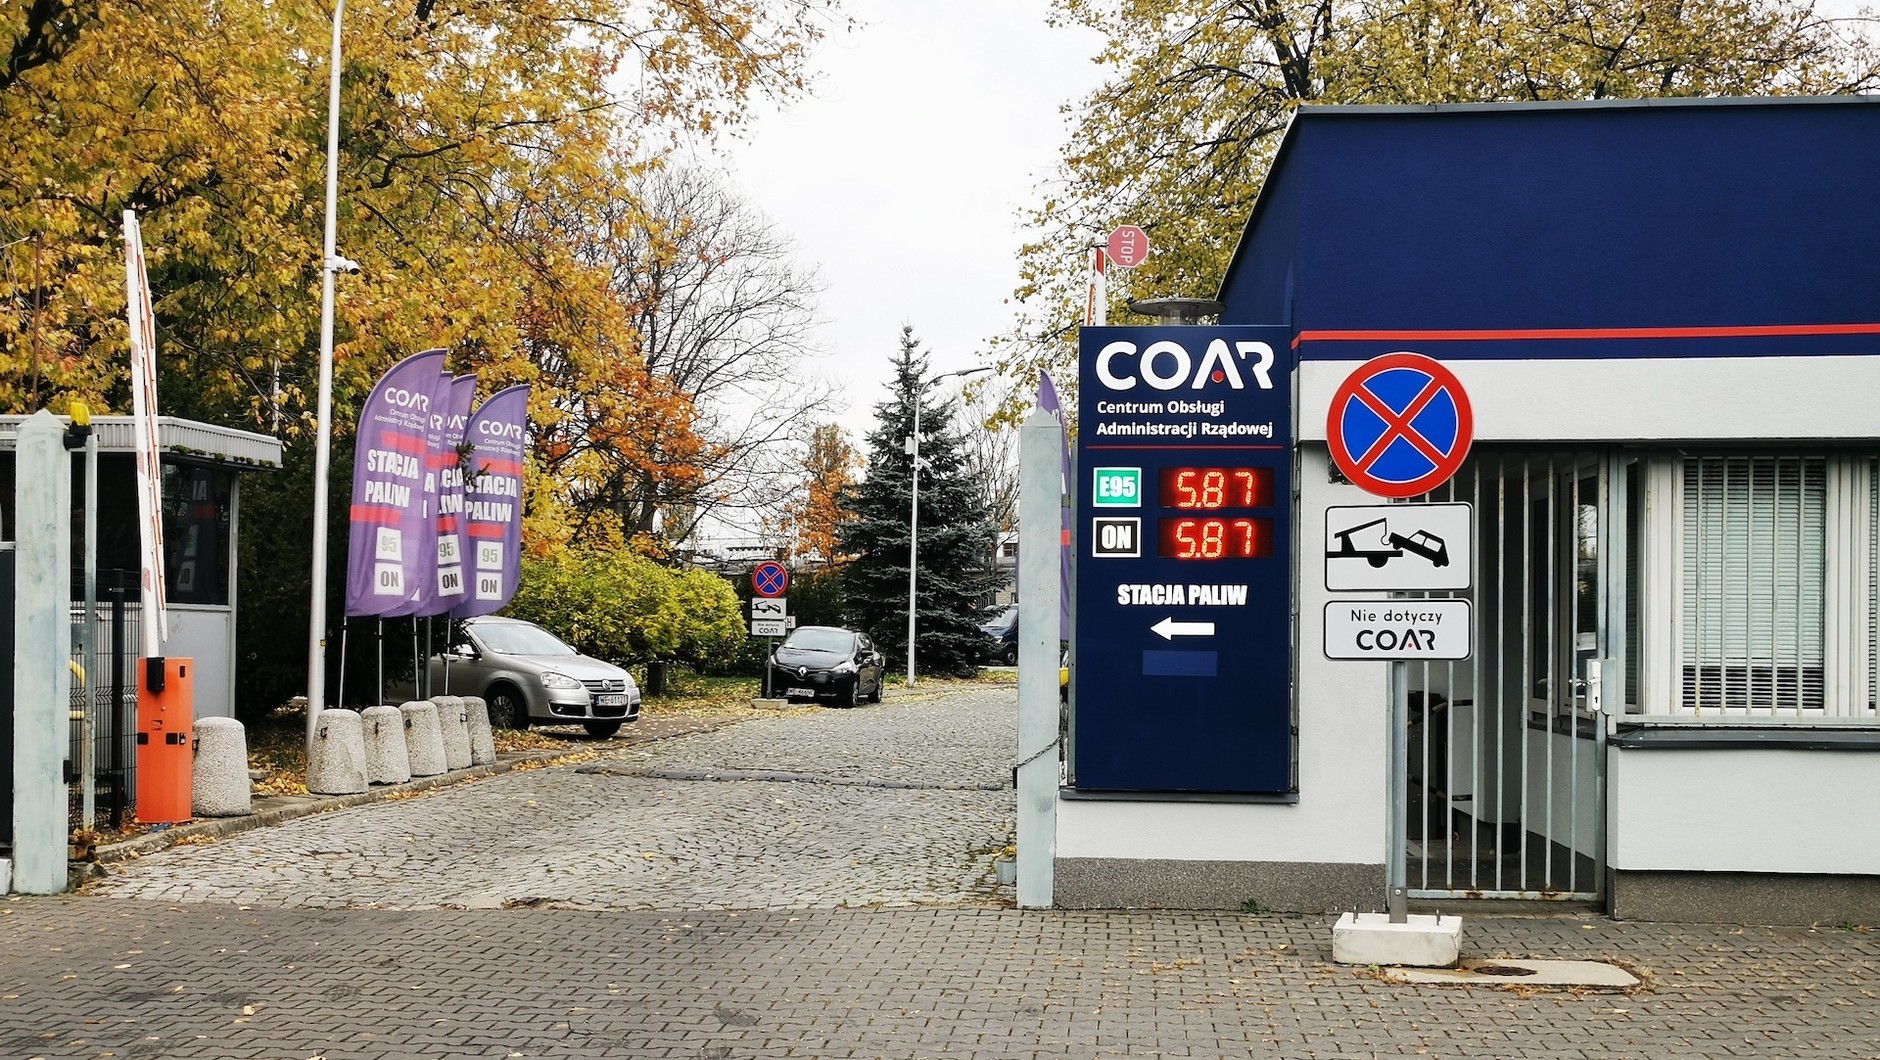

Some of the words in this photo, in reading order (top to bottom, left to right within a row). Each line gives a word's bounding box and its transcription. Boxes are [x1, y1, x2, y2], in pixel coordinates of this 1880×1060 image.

[1120, 230, 1135, 264] STOP
[1096, 338, 1275, 391] COAR
[384, 387, 430, 412] COAR
[1097, 400, 1164, 414] Centrum
[1167, 400, 1225, 417] Obsługi
[479, 420, 523, 440] COAR
[1096, 421, 1197, 439] Administracji
[1201, 421, 1273, 439] Rządowej
[367, 449, 419, 480] STACJA
[441, 468, 464, 488] CJA
[1099, 475, 1137, 498] E95
[364, 480, 411, 508] PALIW
[1177, 471, 1253, 508] 5.87
[464, 501, 513, 522] PALIW
[381, 535, 398, 553] 95
[1101, 524, 1132, 550] ON
[1176, 521, 1253, 559] 5.87
[439, 542, 455, 558] 95
[482, 547, 499, 563] 95
[380, 570, 400, 587] ON
[441, 573, 459, 589] ON
[481, 578, 498, 593] ON
[1117, 584, 1185, 606] STACJA
[1188, 584, 1248, 606] PALIW
[1351, 609, 1377, 622] Nie
[1383, 609, 1443, 625] dotyczy
[1356, 628, 1436, 651] COAR
